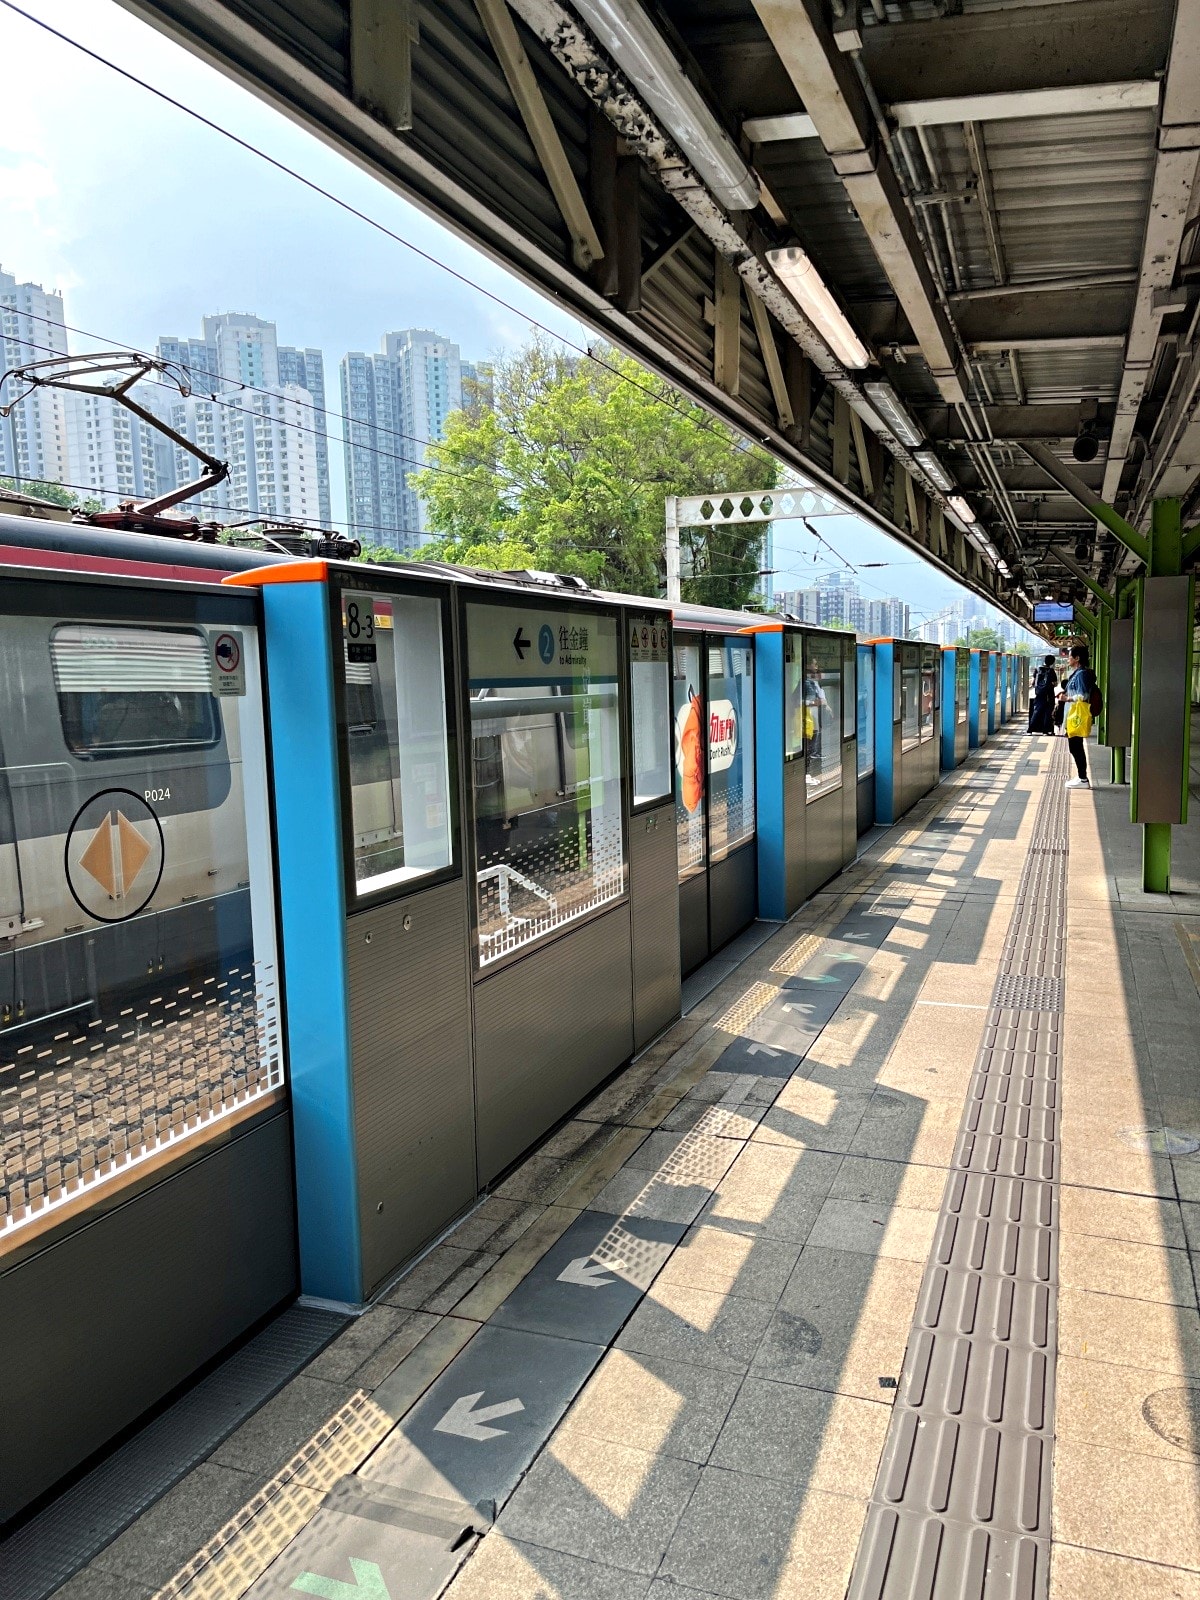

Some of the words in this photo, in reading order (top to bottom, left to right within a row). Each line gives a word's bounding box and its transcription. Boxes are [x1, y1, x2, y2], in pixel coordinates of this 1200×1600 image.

[347, 602, 374, 639] 8-3
[559, 625, 589, 651] 往金鐘
[559, 656, 564, 665] to
[565, 654, 587, 667] Admiralty
[144, 787, 171, 802] P024
